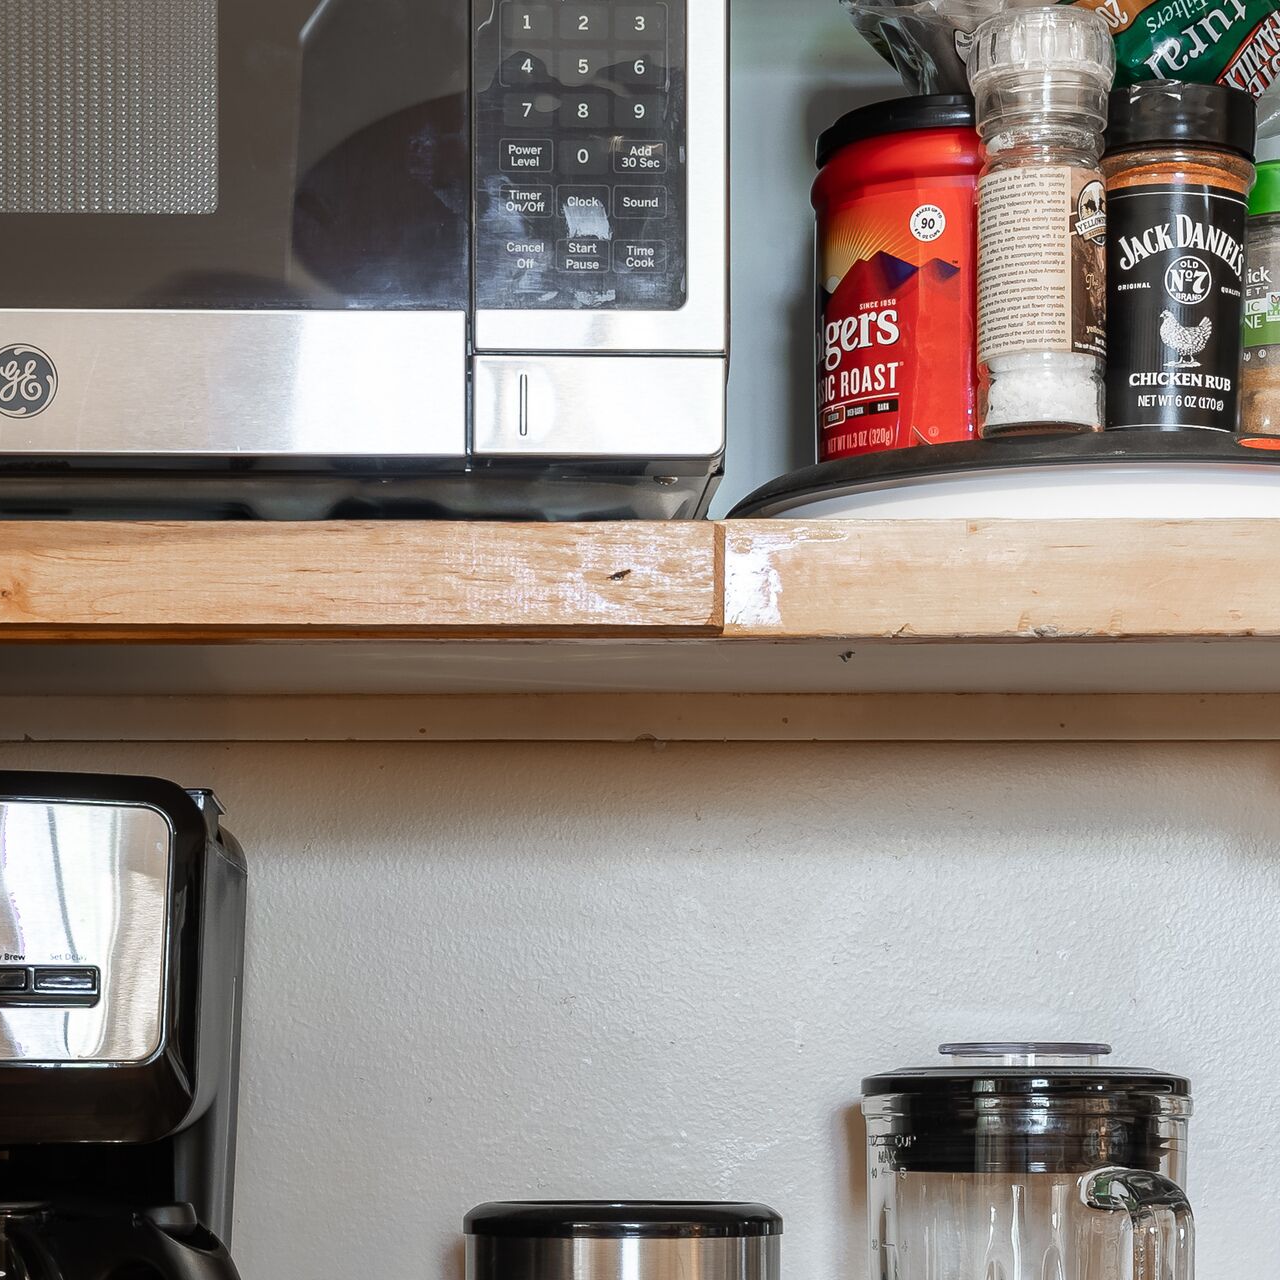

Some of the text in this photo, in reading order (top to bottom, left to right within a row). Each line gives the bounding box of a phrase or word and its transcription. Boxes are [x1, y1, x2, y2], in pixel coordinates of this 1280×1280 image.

[523, 14, 531, 30] 1
[1146, 0, 1208, 33] Filters
[578, 15, 589, 30] 2
[634, 16, 645, 31] 3
[521, 58, 533, 73] 4
[578, 59, 589, 74] 5
[633, 59, 645, 74] 6
[522, 103, 532, 117] 7
[577, 103, 589, 118] 8
[633, 104, 645, 118] 9
[508, 144, 542, 155] Power
[630, 146, 652, 156] Add
[511, 156, 539, 167] Level
[577, 149, 589, 163] 0
[622, 158, 660, 168] 30 Sec
[509, 190, 542, 200] Timer
[506, 202, 545, 212] On/Off
[567, 196, 599, 207] Clock
[623, 197, 658, 207] Sound
[921, 218, 935, 229] 90
[506, 243, 544, 253] Cancel
[568, 243, 597, 253] Start
[626, 246, 654, 256] Time
[1118, 223, 1175, 270] JACK
[517, 259, 535, 269] Off
[566, 260, 599, 270] Pause
[626, 258, 654, 268] Cook
[1180, 260, 1199, 268] OLD
[1118, 282, 1151, 291] ORIGINAL
[1175, 293, 1202, 301] BRAND
[859, 300, 878, 310] SINCE
[840, 361, 899, 398] ROAST
[1129, 372, 1231, 391] CHICKEN RUB
[1138, 395, 1224, 411] NET WT 6 OZ (170g)
